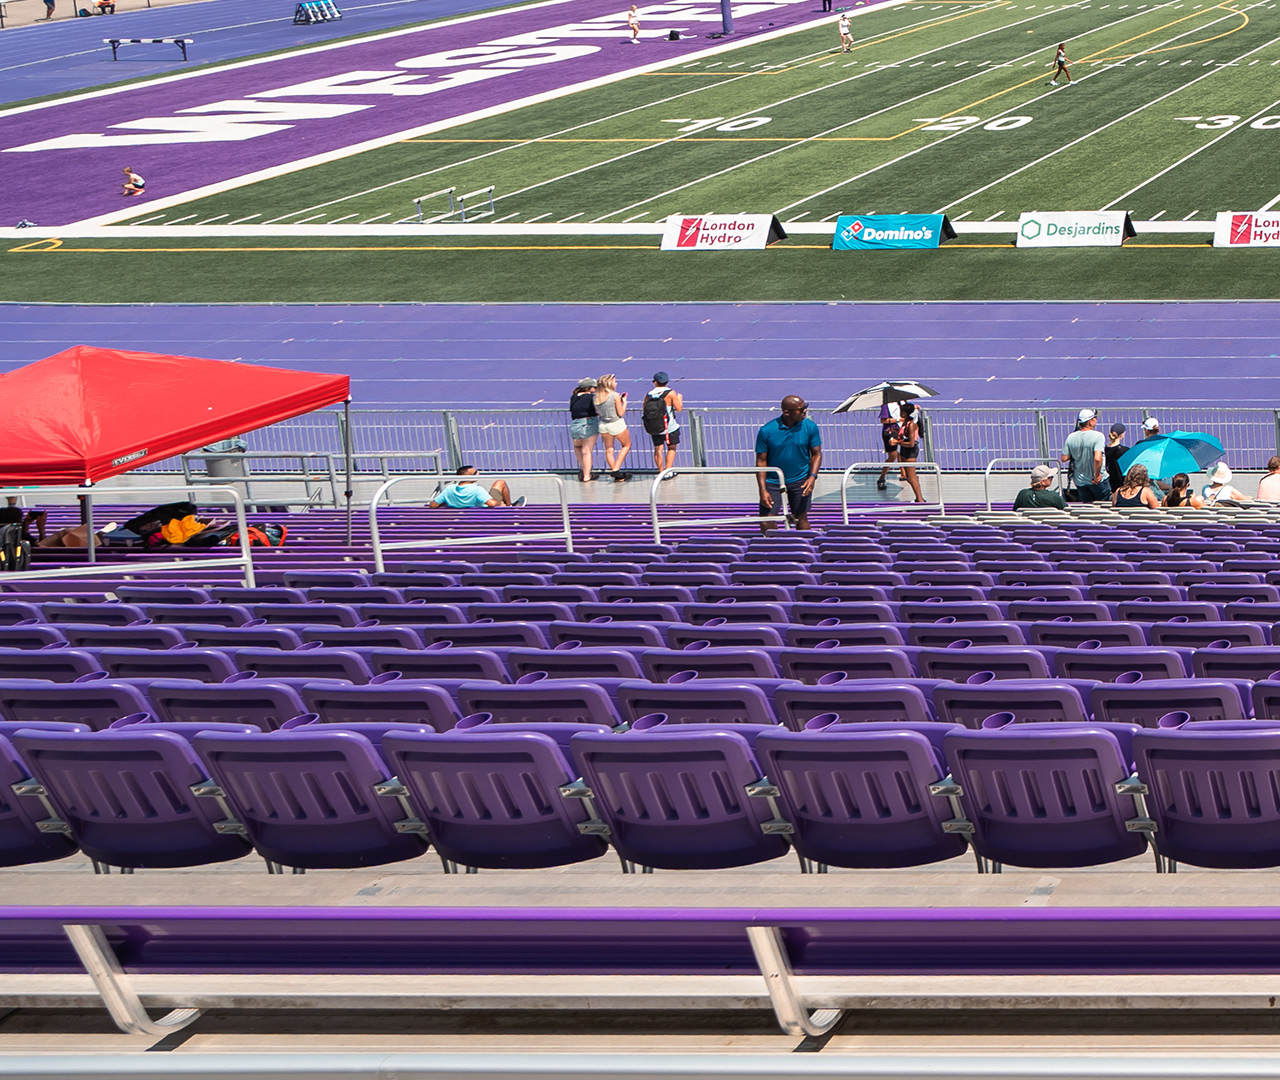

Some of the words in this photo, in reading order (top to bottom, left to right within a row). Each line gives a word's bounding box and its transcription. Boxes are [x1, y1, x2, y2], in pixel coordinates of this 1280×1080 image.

[678, 118, 771, 131] 10
[924, 117, 1033, 130] 20
[701, 220, 755, 231] London
[1046, 222, 1121, 237] Desjardins
[700, 233, 742, 245] Hydro
[862, 226, 933, 240] Domino's
